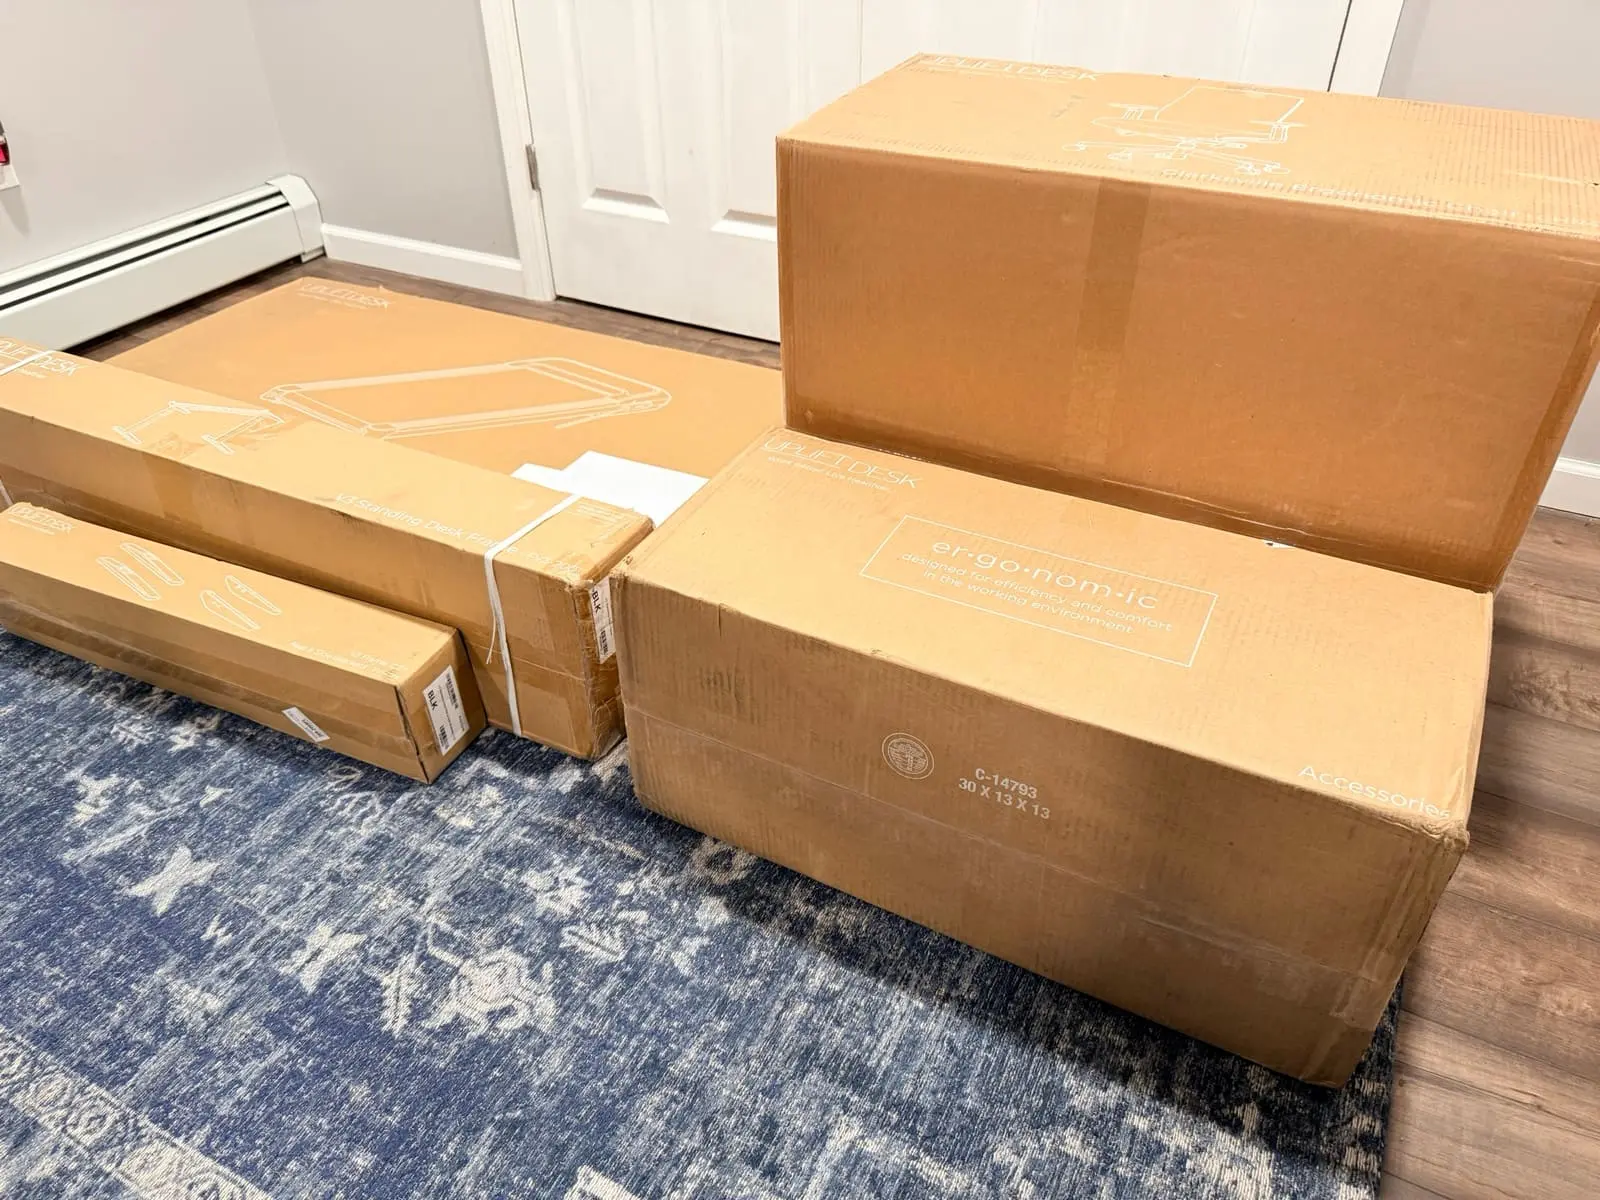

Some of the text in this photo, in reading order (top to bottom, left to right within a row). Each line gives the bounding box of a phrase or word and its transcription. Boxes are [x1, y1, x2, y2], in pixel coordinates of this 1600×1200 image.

[763, 436, 852, 467] UPLIFT
[847, 460, 923, 489] DESK
[354, 499, 421, 526] Standing
[424, 520, 462, 537] Desk
[901, 553, 1173, 632] designed for efficiency and comfort
[923, 570, 1135, 633] in the working environment
[427, 690, 438, 711] BLK
[958, 777, 1051, 820] 30 X 13 X 13
[975, 767, 1038, 799] C-14793
